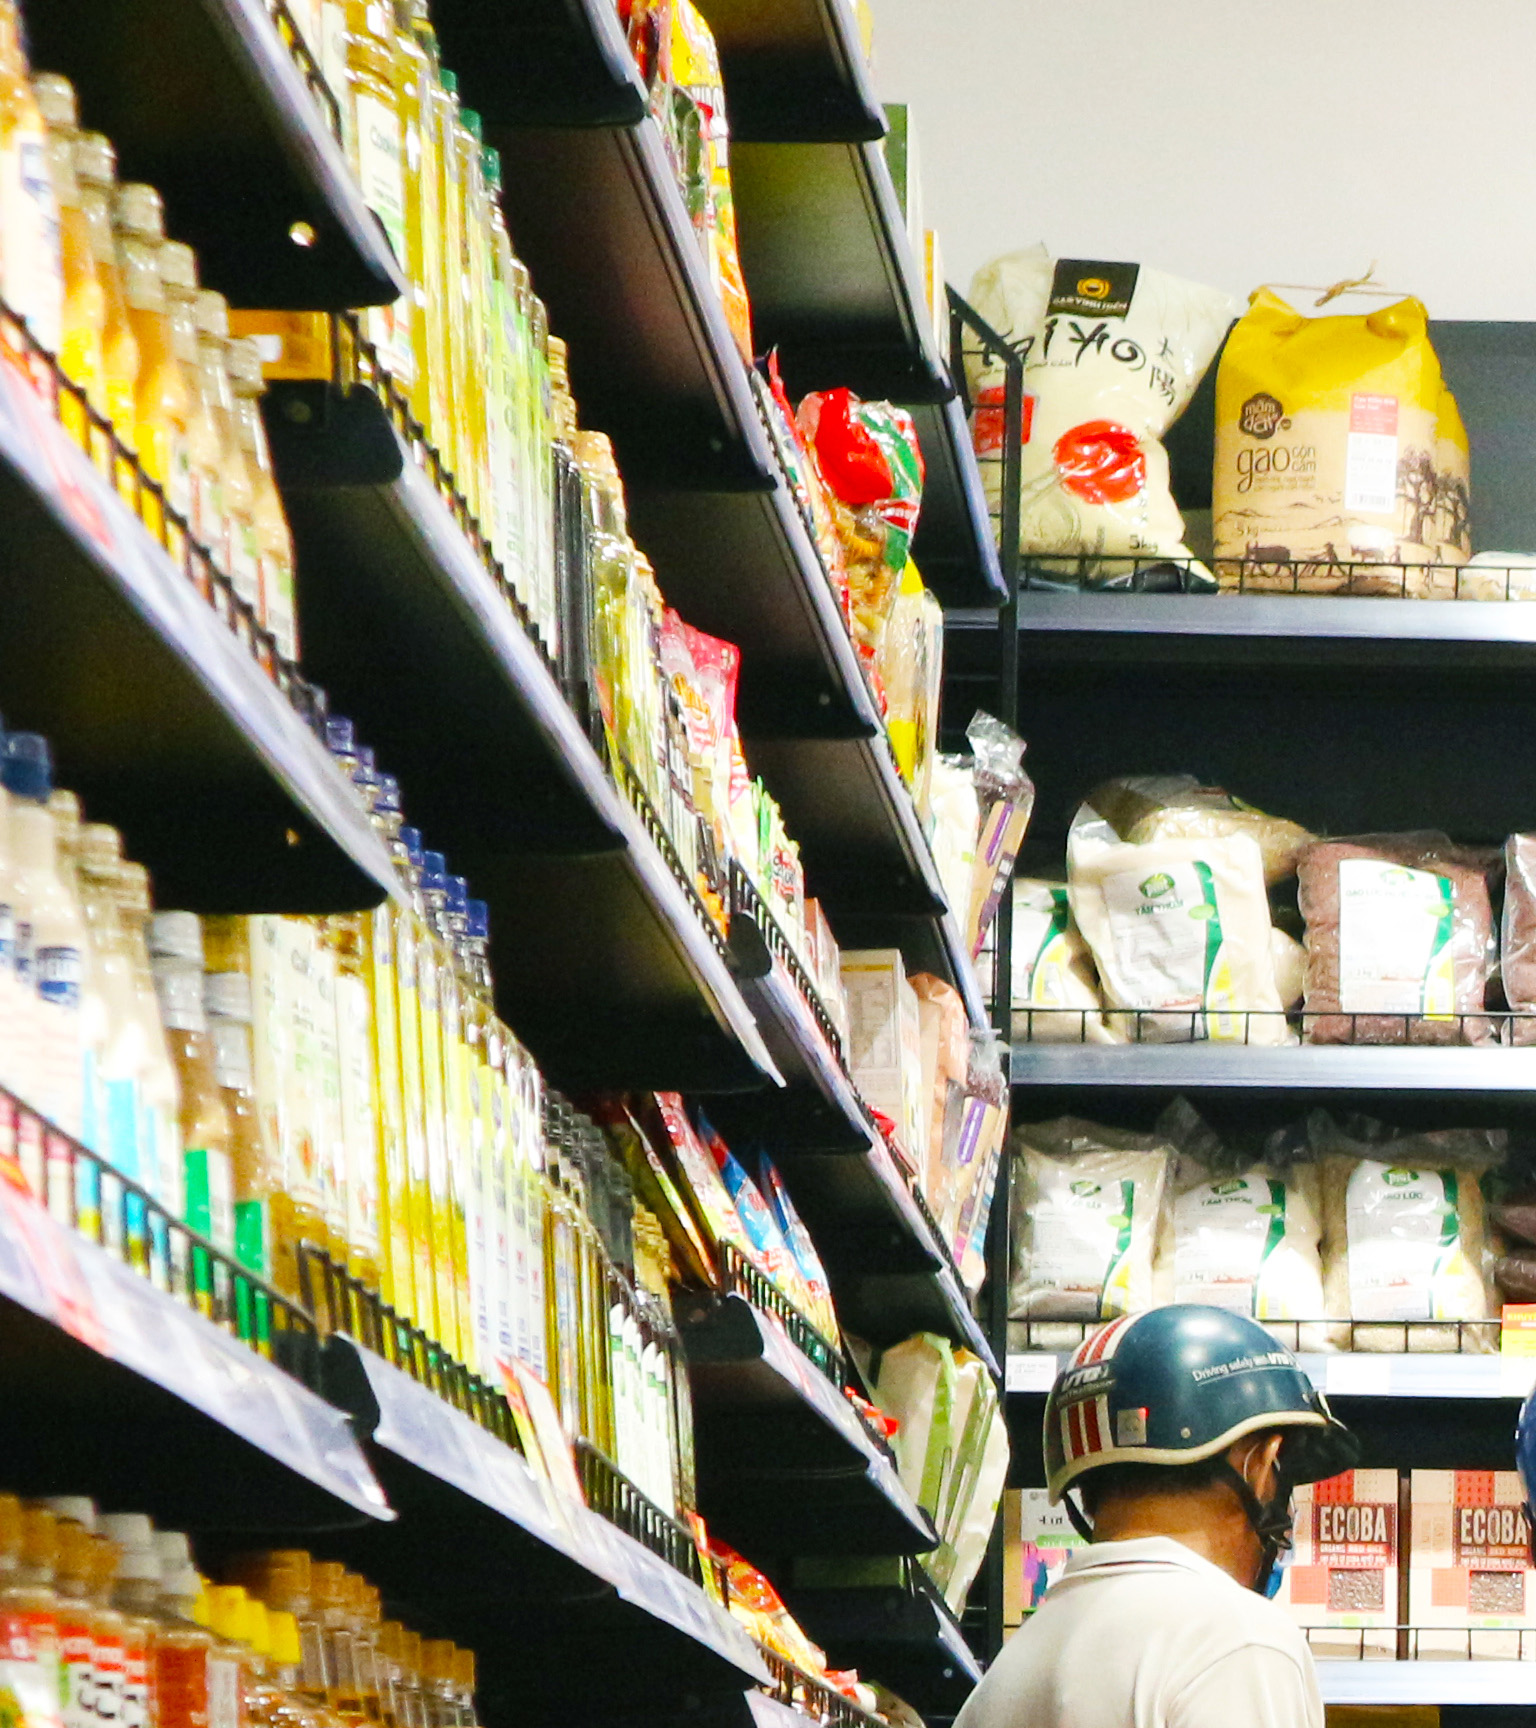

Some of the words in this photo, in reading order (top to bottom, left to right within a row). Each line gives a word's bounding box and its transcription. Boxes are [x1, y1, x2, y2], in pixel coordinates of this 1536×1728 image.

[1192, 1363, 1229, 1382] Driving
[1319, 1506, 1388, 1543] ECOBA
[1460, 1508, 1528, 1545] ECOBA
